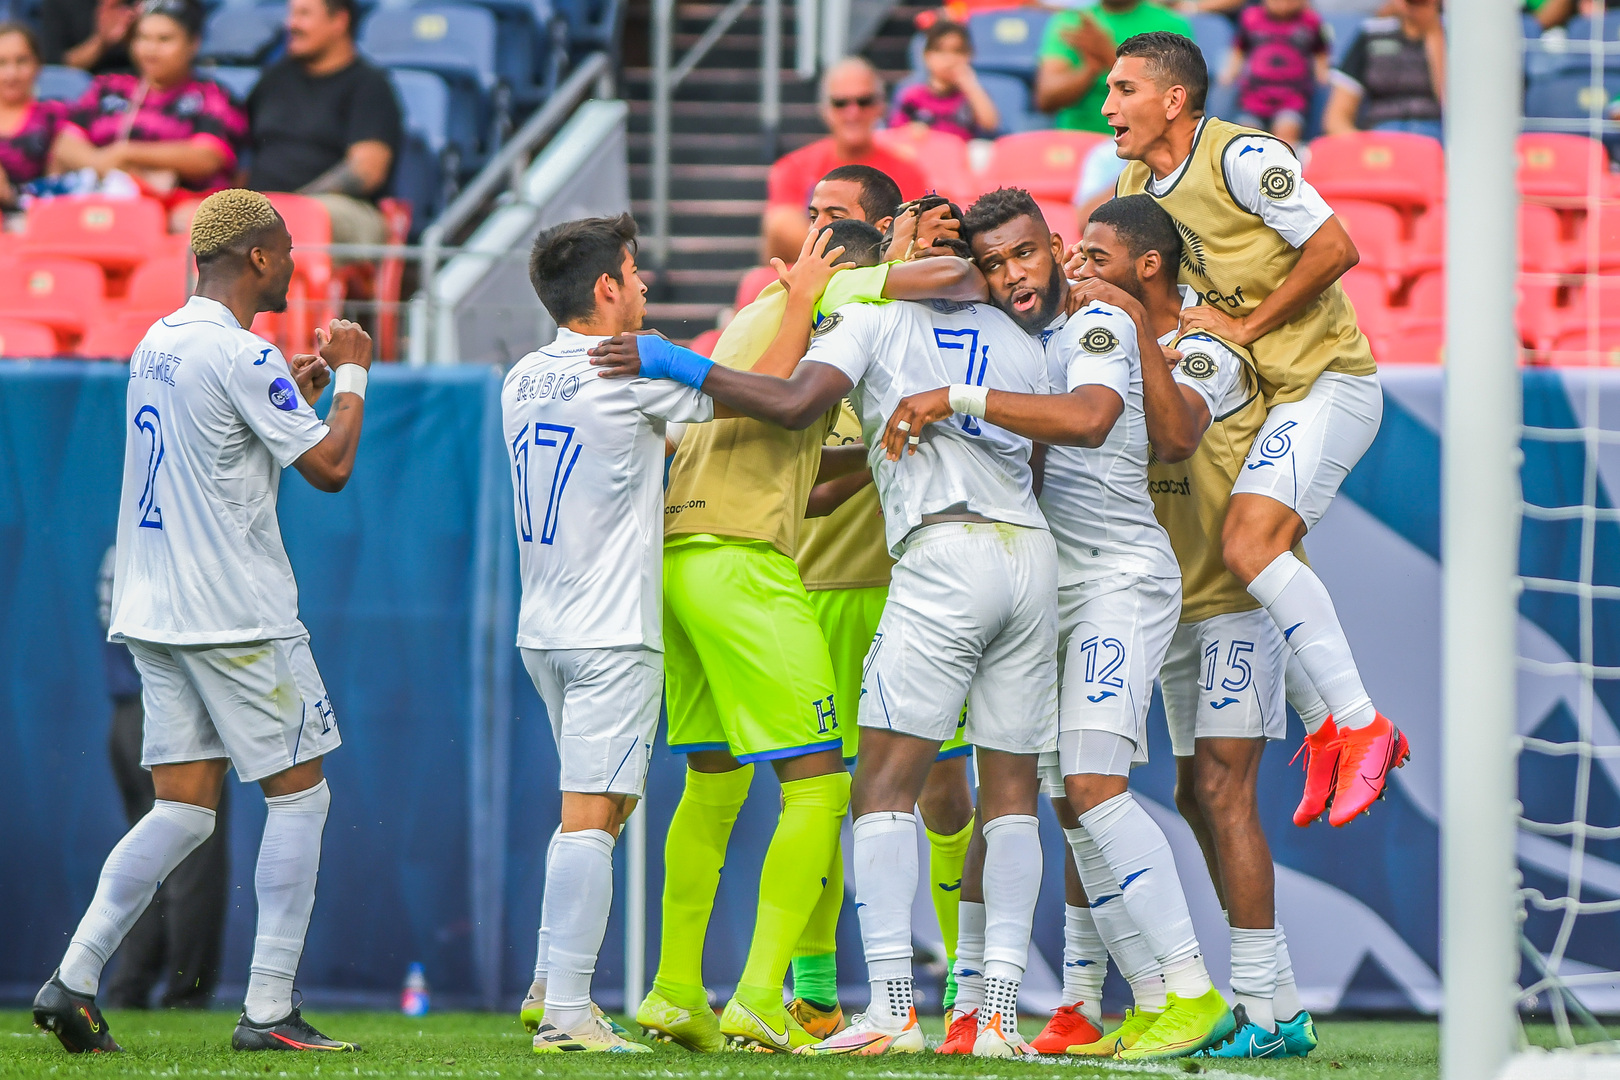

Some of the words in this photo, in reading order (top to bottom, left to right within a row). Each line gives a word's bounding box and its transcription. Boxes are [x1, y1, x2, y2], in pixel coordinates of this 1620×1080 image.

[1273, 178, 1284, 188] 60
[517, 372, 580, 401] RUBIO
[933, 327, 990, 437] 7
[133, 404, 165, 530] 2
[513, 421, 584, 546] 17
[1081, 635, 1126, 689] 12
[1205, 639, 1255, 693] 15
